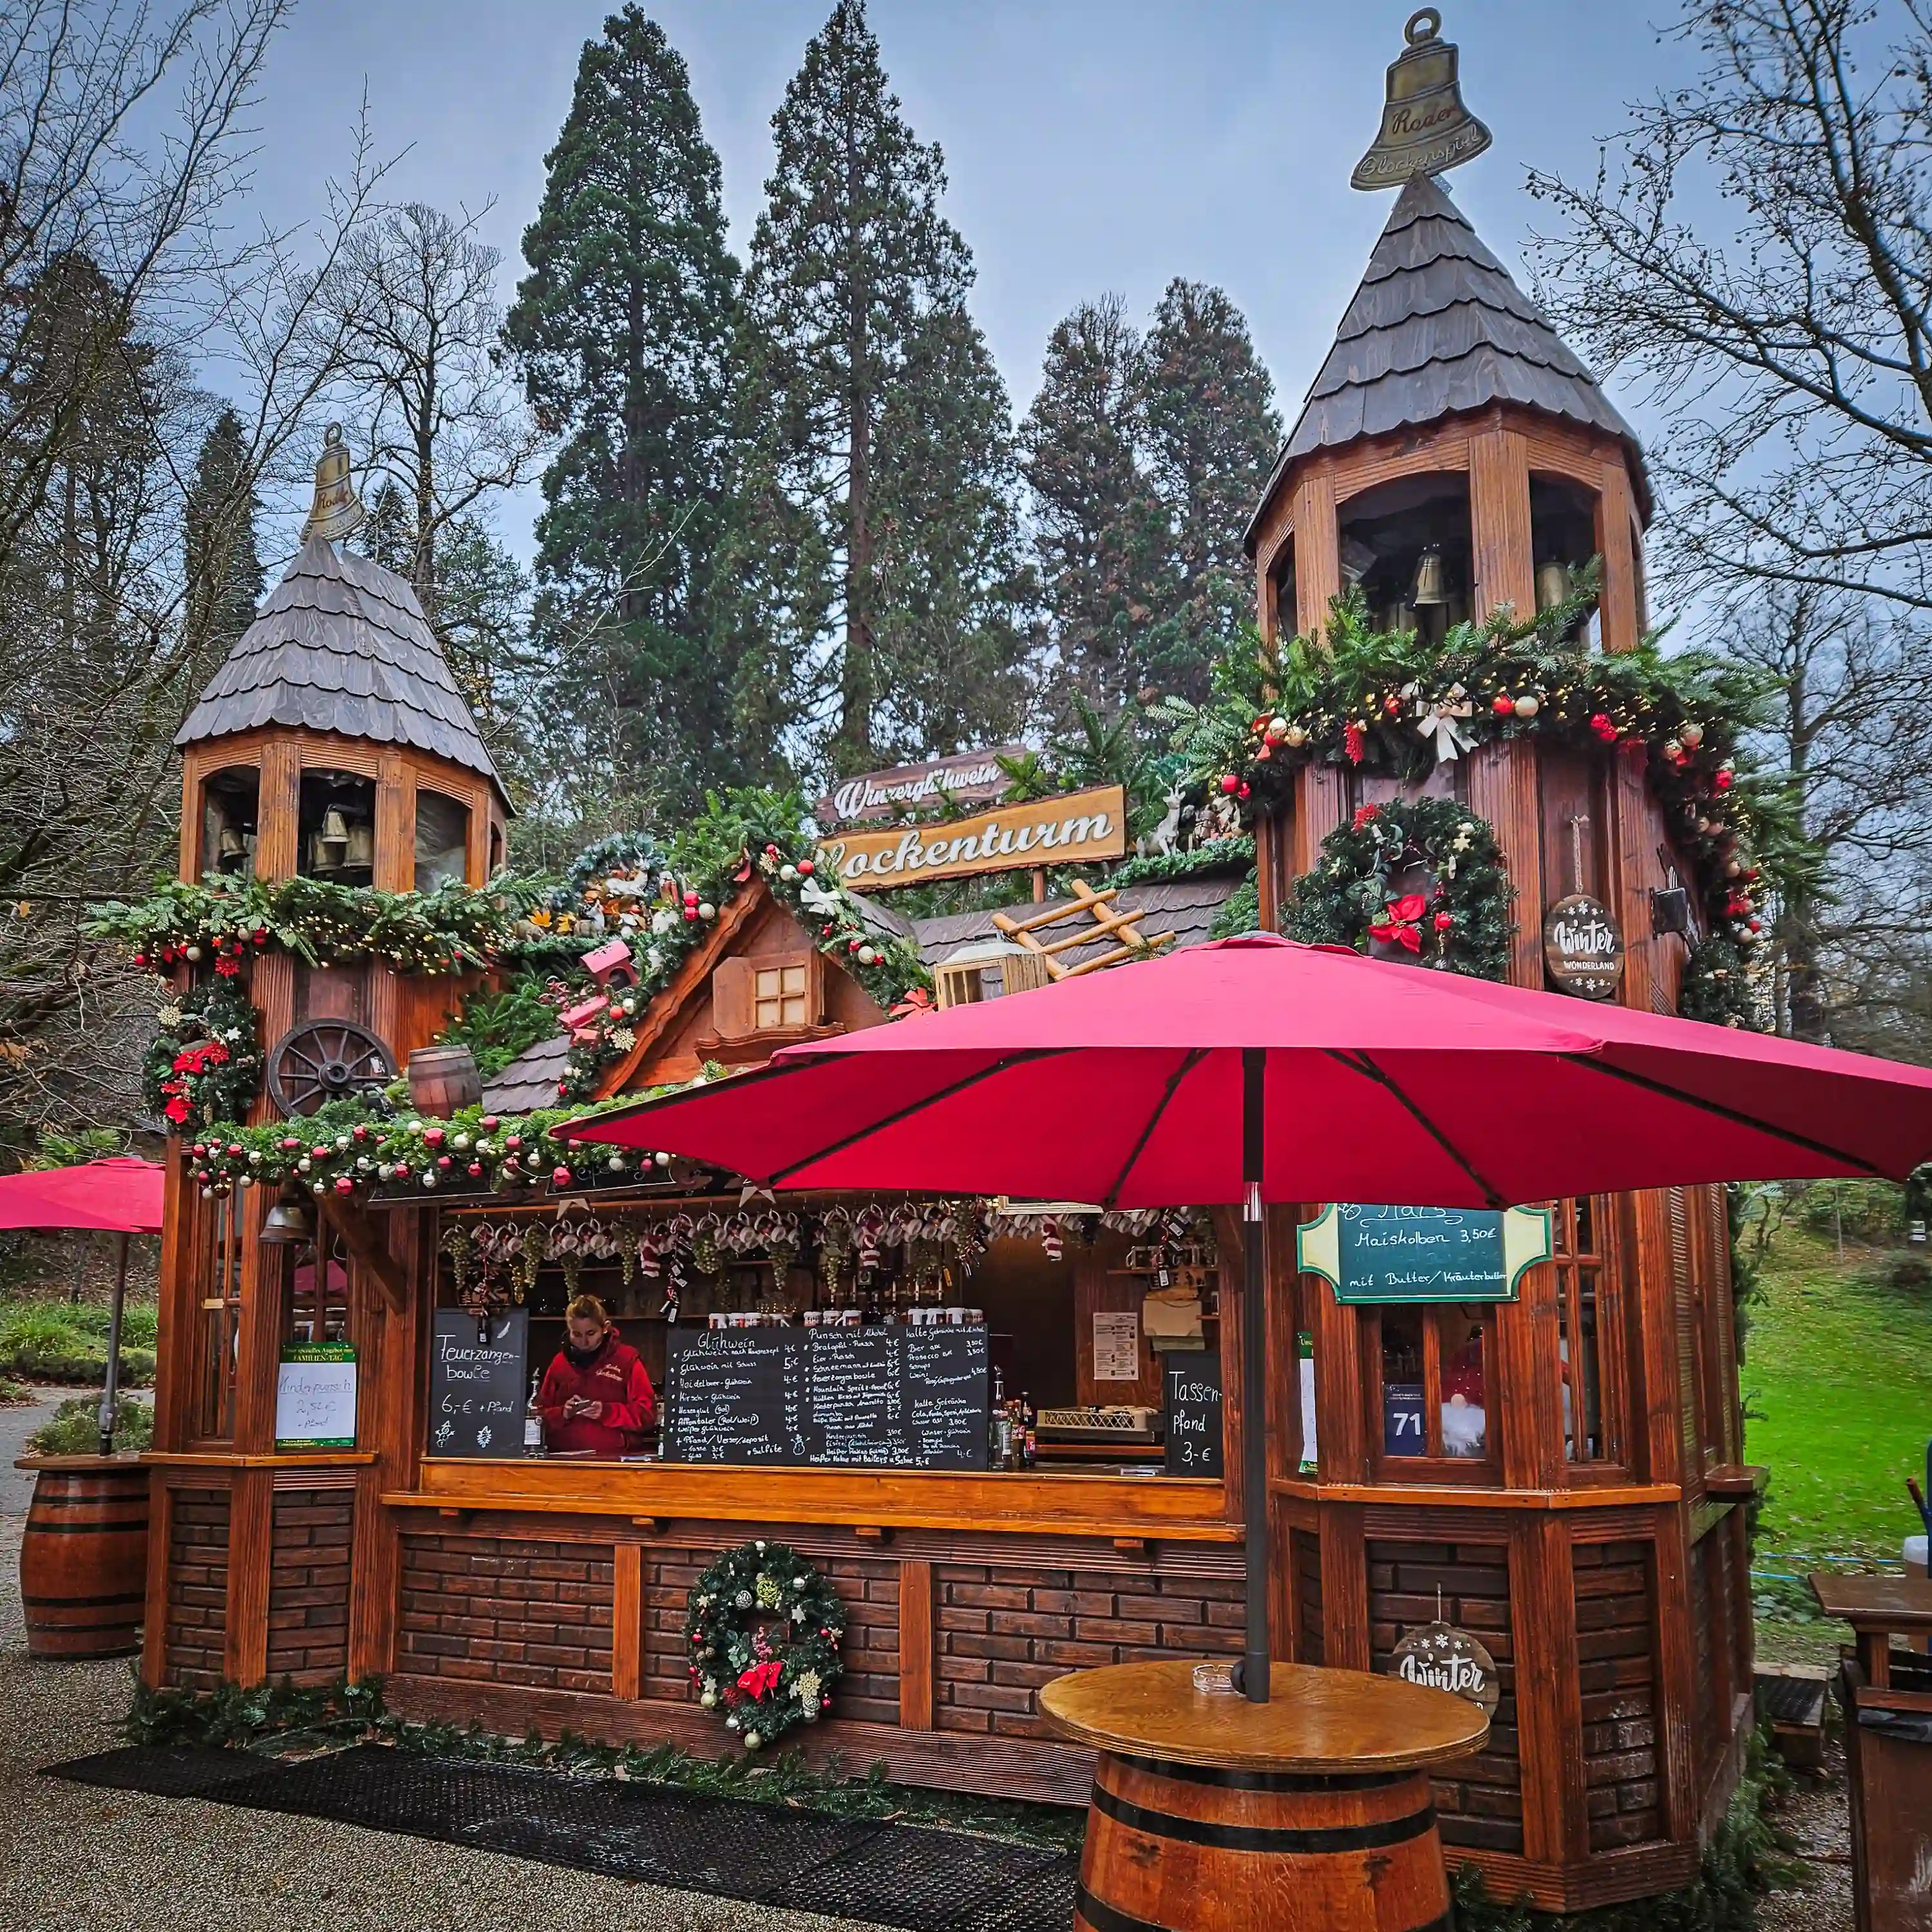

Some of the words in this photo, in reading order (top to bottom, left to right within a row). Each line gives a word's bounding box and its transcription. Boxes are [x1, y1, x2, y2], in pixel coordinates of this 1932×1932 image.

[1554, 919, 1615, 954] Winter
[1564, 961, 1615, 970] WONDERLAND
[1355, 1229, 1450, 1247] Maiskolben
[1461, 1227, 1497, 1243] 3,50€
[1349, 1274, 1374, 1287] mit
[697, 1332, 755, 1350] Glühwein
[809, 1328, 843, 1340] Punsch
[846, 1329, 860, 1338] mit
[446, 1364, 490, 1379] bowle
[1169, 1371, 1222, 1402] Tassen-
[1393, 1413, 1421, 1436] 71
[1399, 1653, 1485, 1692] Winter
